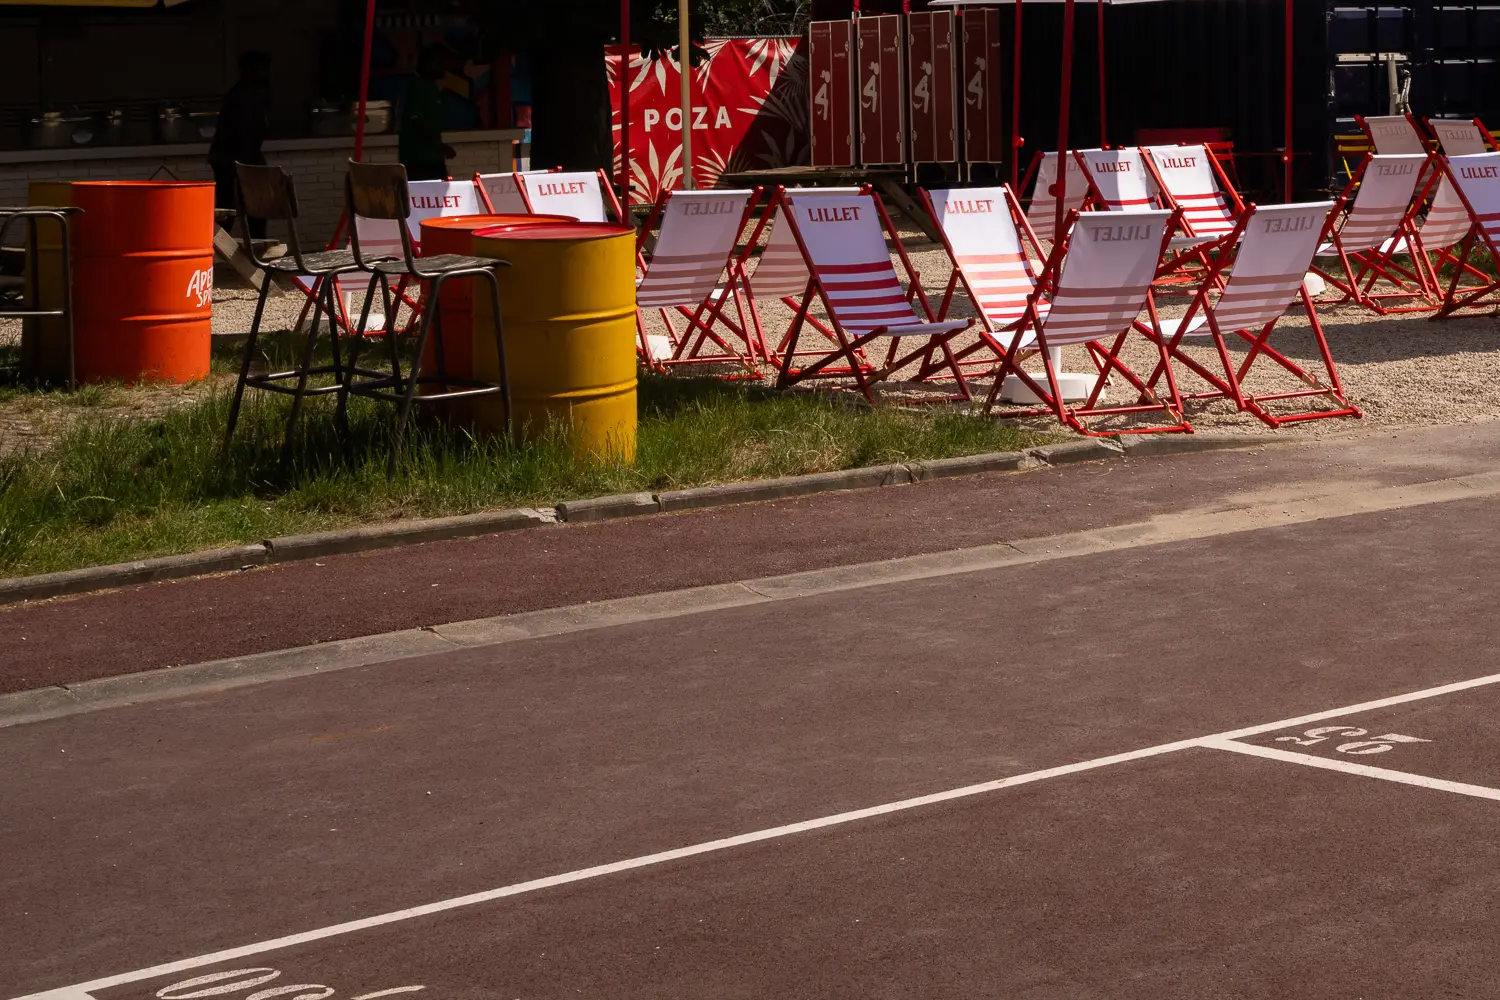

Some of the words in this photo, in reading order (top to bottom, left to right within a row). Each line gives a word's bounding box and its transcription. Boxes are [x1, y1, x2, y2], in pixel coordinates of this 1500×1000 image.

[643, 106, 732, 132] POZA
[1095, 161, 1131, 173] LILLET
[1162, 156, 1197, 169] LILLET
[1460, 166, 1499, 180] LILLET
[538, 181, 587, 196] LILLET
[411, 195, 461, 209] LILLET
[945, 199, 994, 214] LILLET
[807, 206, 862, 222] LILLET
